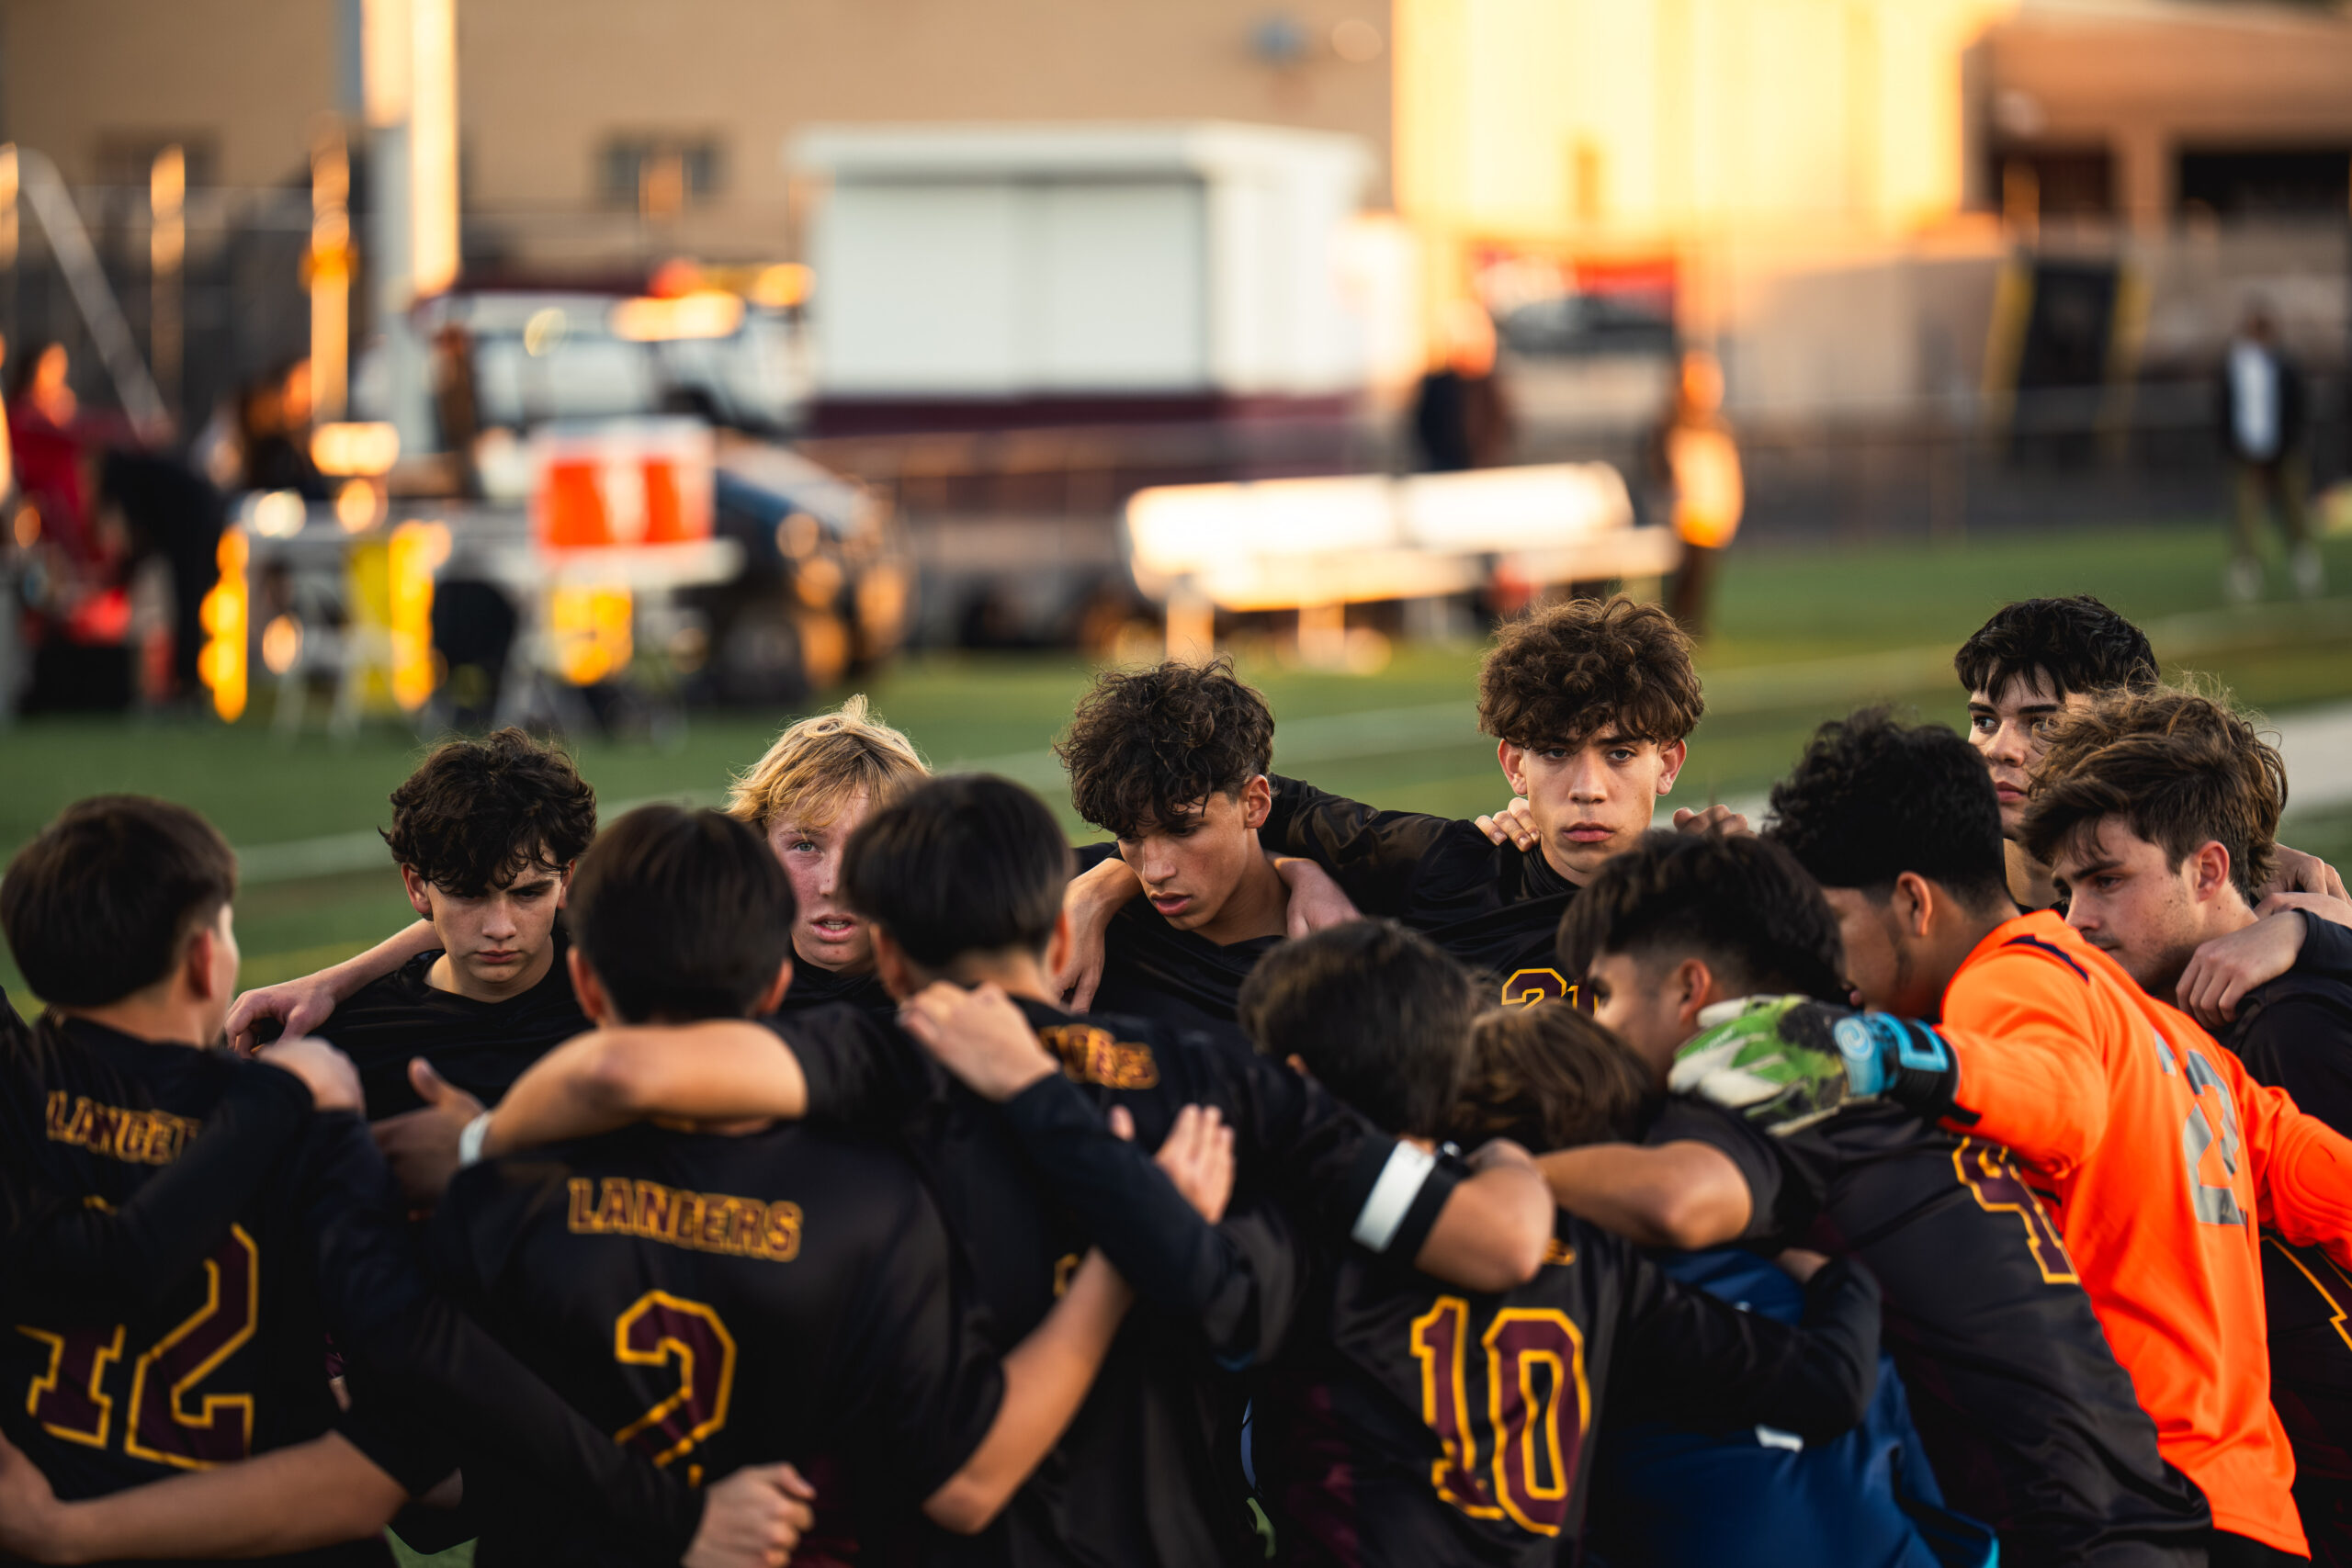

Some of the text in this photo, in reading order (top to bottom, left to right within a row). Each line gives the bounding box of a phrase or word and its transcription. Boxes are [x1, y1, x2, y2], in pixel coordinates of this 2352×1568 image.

[567, 1177, 804, 1263] LANCERS
[615, 1290, 737, 1481] 2
[1409, 1294, 1591, 1538] 10
